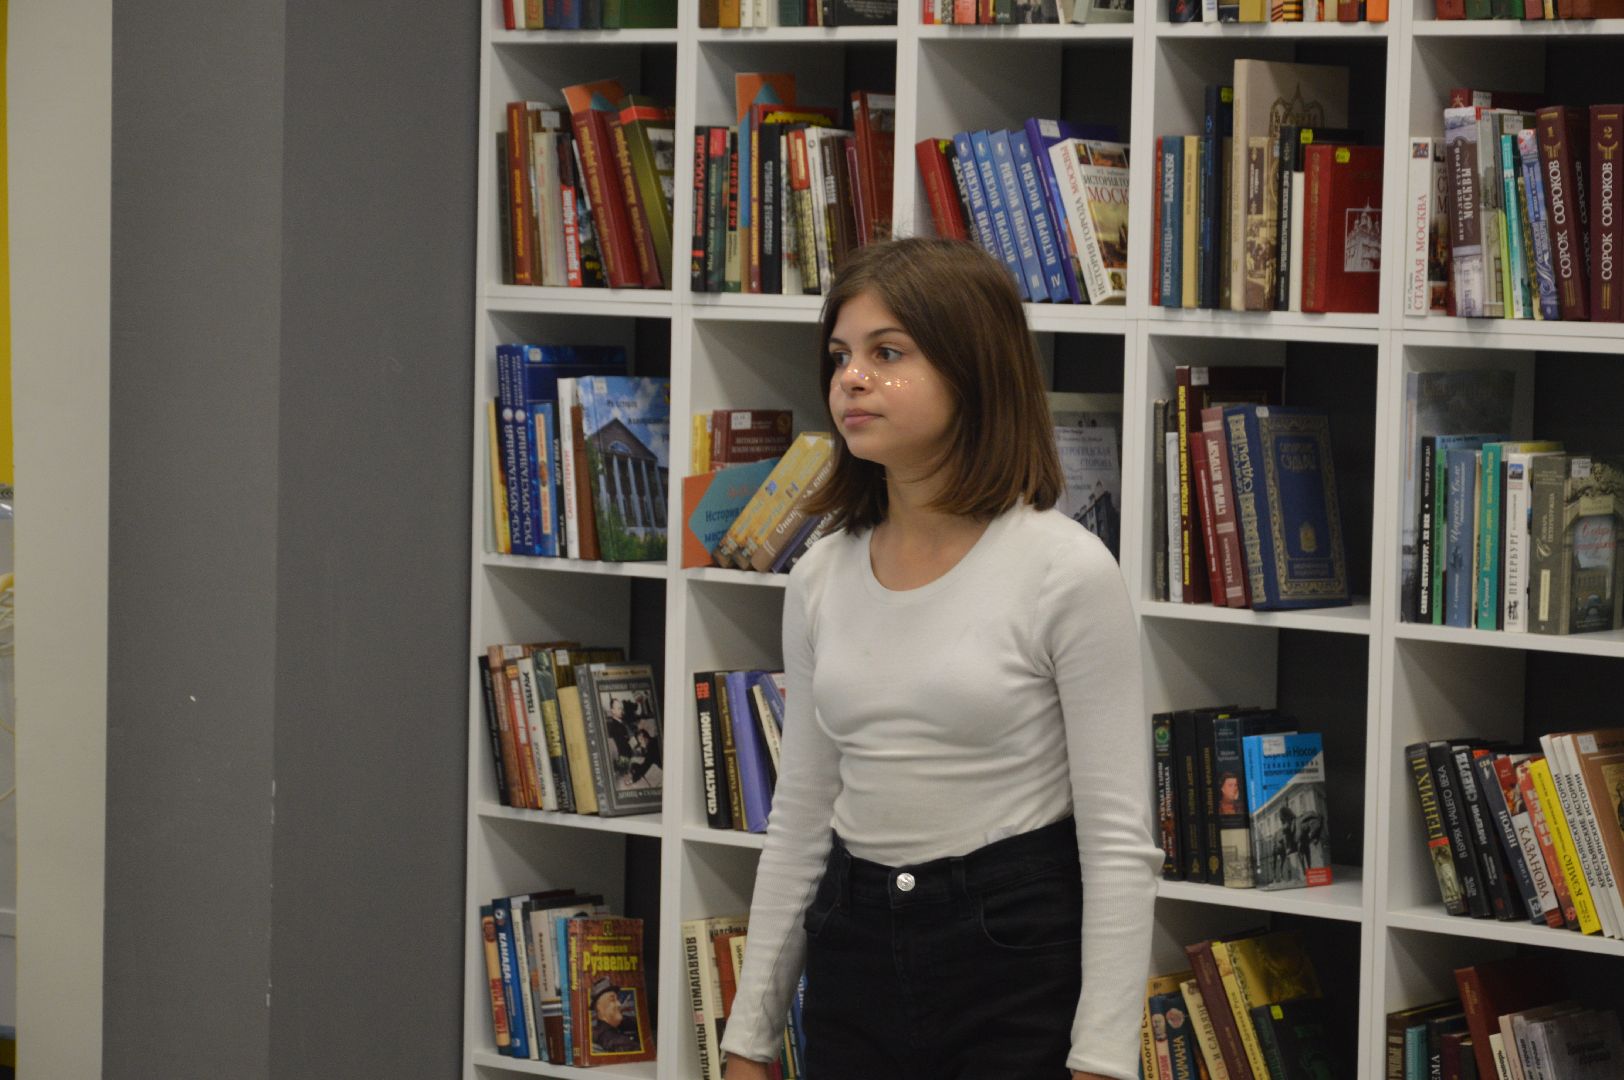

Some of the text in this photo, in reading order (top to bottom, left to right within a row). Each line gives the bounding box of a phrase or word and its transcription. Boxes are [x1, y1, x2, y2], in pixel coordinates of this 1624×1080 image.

[962, 159, 984, 209] МОСКВЫ
[981, 159, 1016, 263] ИСТОРИЯ МОСКВЫ
[999, 161, 1033, 258] ИСТОРИЯ МОСКВЫ
[1020, 161, 1041, 210] МОСКВЫ
[1453, 146, 1465, 241] ПЕРЕУЛКИ СТАРОЙ
[1461, 167, 1475, 219] МОСКВЫ
[1548, 158, 1573, 278] СОРОК СОРОКОВ
[1033, 212, 1057, 266] ИСТОРИЯ
[1060, 144, 1107, 296] ИСТОРИЯ ГОРОДА МОСКВЫ
[1413, 193, 1428, 310] СТАРАЯ МОСКВА
[1601, 161, 1614, 281] СОРОК СОРОКОВ
[505, 424, 521, 544] ГУСЬ-ХРУСТАЛЬНЫЙ
[517, 425, 532, 546] ГУСЬ-ХРУСТАЛЬНЫЙ
[1180, 481, 1190, 516] ЛЕГЕНДЫ
[1508, 532, 1519, 596] ПЕТЕРБУРГ
[699, 711, 715, 768] ИТАЛИЮ!
[704, 769, 718, 815] СПАСТИ
[1415, 771, 1443, 839] ГЕНРИХ
[1437, 764, 1450, 787] ВЕКА
[1443, 789, 1459, 826] НАШЕГО
[1454, 752, 1478, 802] СМЕРТИ
[1498, 809, 1518, 848] НЕРОН
[1518, 825, 1549, 898] КАЗАНОВА
[1554, 773, 1596, 887] КРЕСТЬЯНСКИЕ ИСТОРИИ
[1565, 774, 1607, 889] КРЕСТЬЯНСКИЕ ИСТОРИИ
[1574, 773, 1615, 888] КРЕСТЬЯНСКИЕ ИСТОРИИ
[582, 951, 639, 976] Рузвельт
[685, 936, 704, 1012] ТОМАГАВКОВ
[1197, 1003, 1218, 1050] СЛАВЯНЕ
